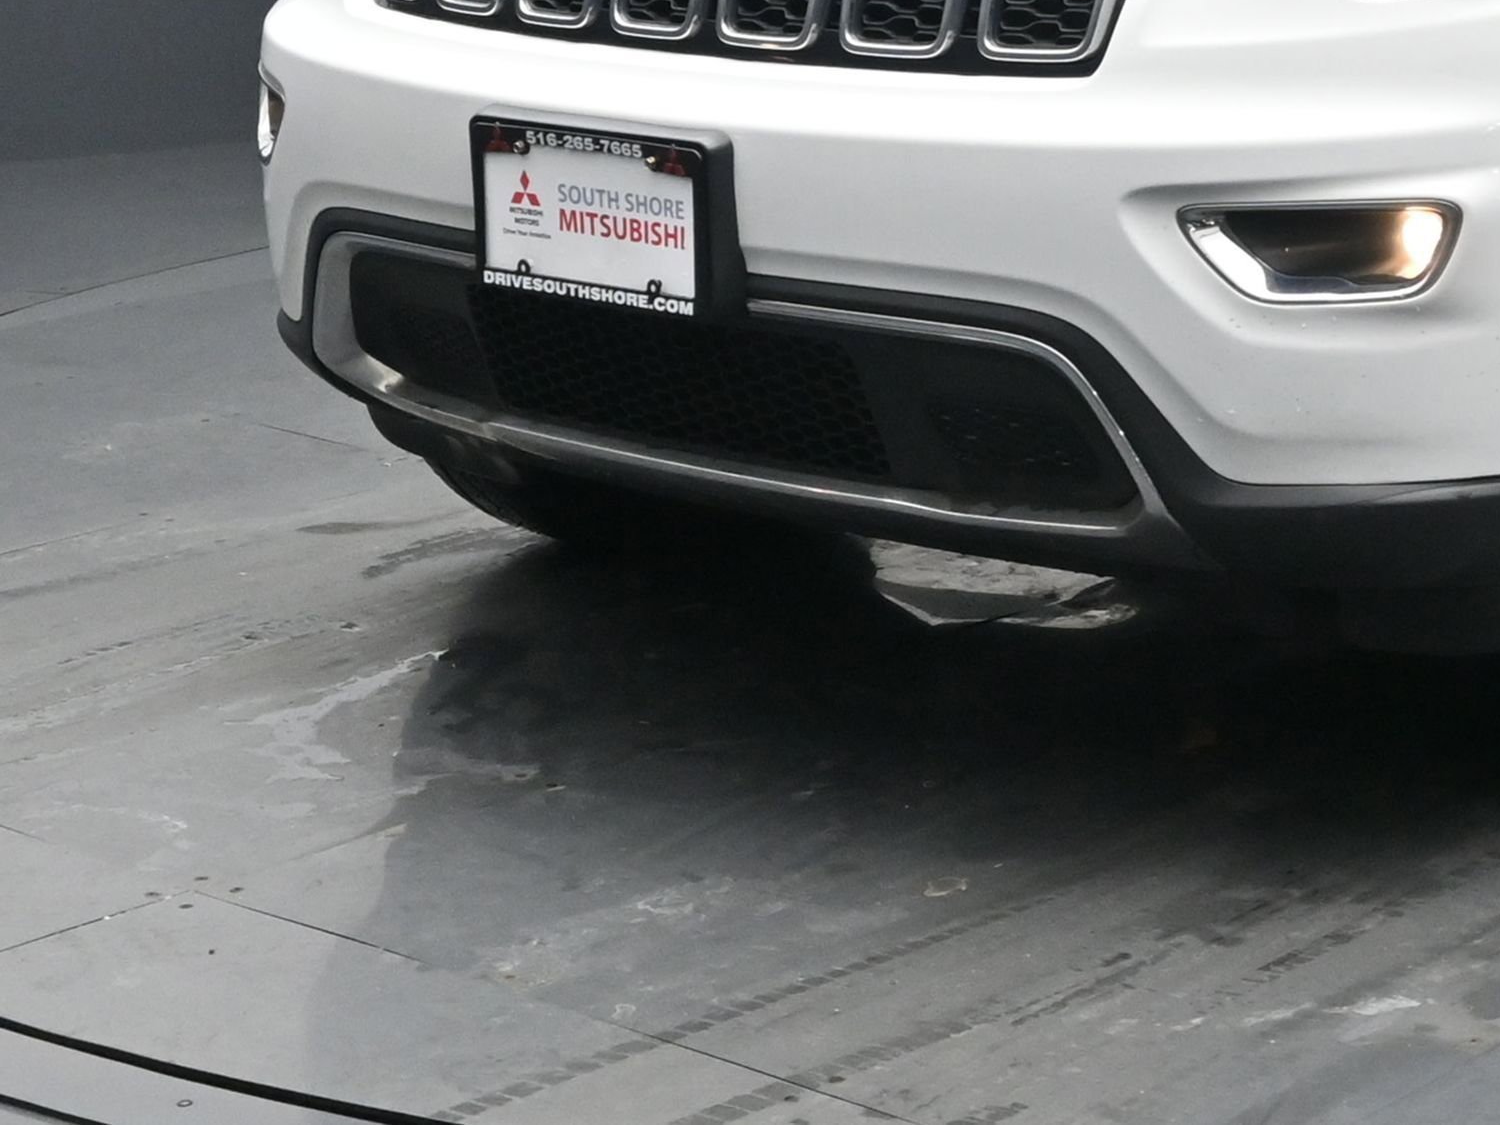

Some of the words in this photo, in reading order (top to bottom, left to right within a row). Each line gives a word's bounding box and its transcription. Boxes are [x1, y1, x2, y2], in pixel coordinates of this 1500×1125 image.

[526, 130, 643, 158] 516-265-7665
[557, 183, 620, 211] SOUTH
[625, 193, 685, 220] SHORE
[559, 208, 686, 250] MITSUBISHI
[483, 270, 694, 316] DRIVESOUTHSHORE.COM
